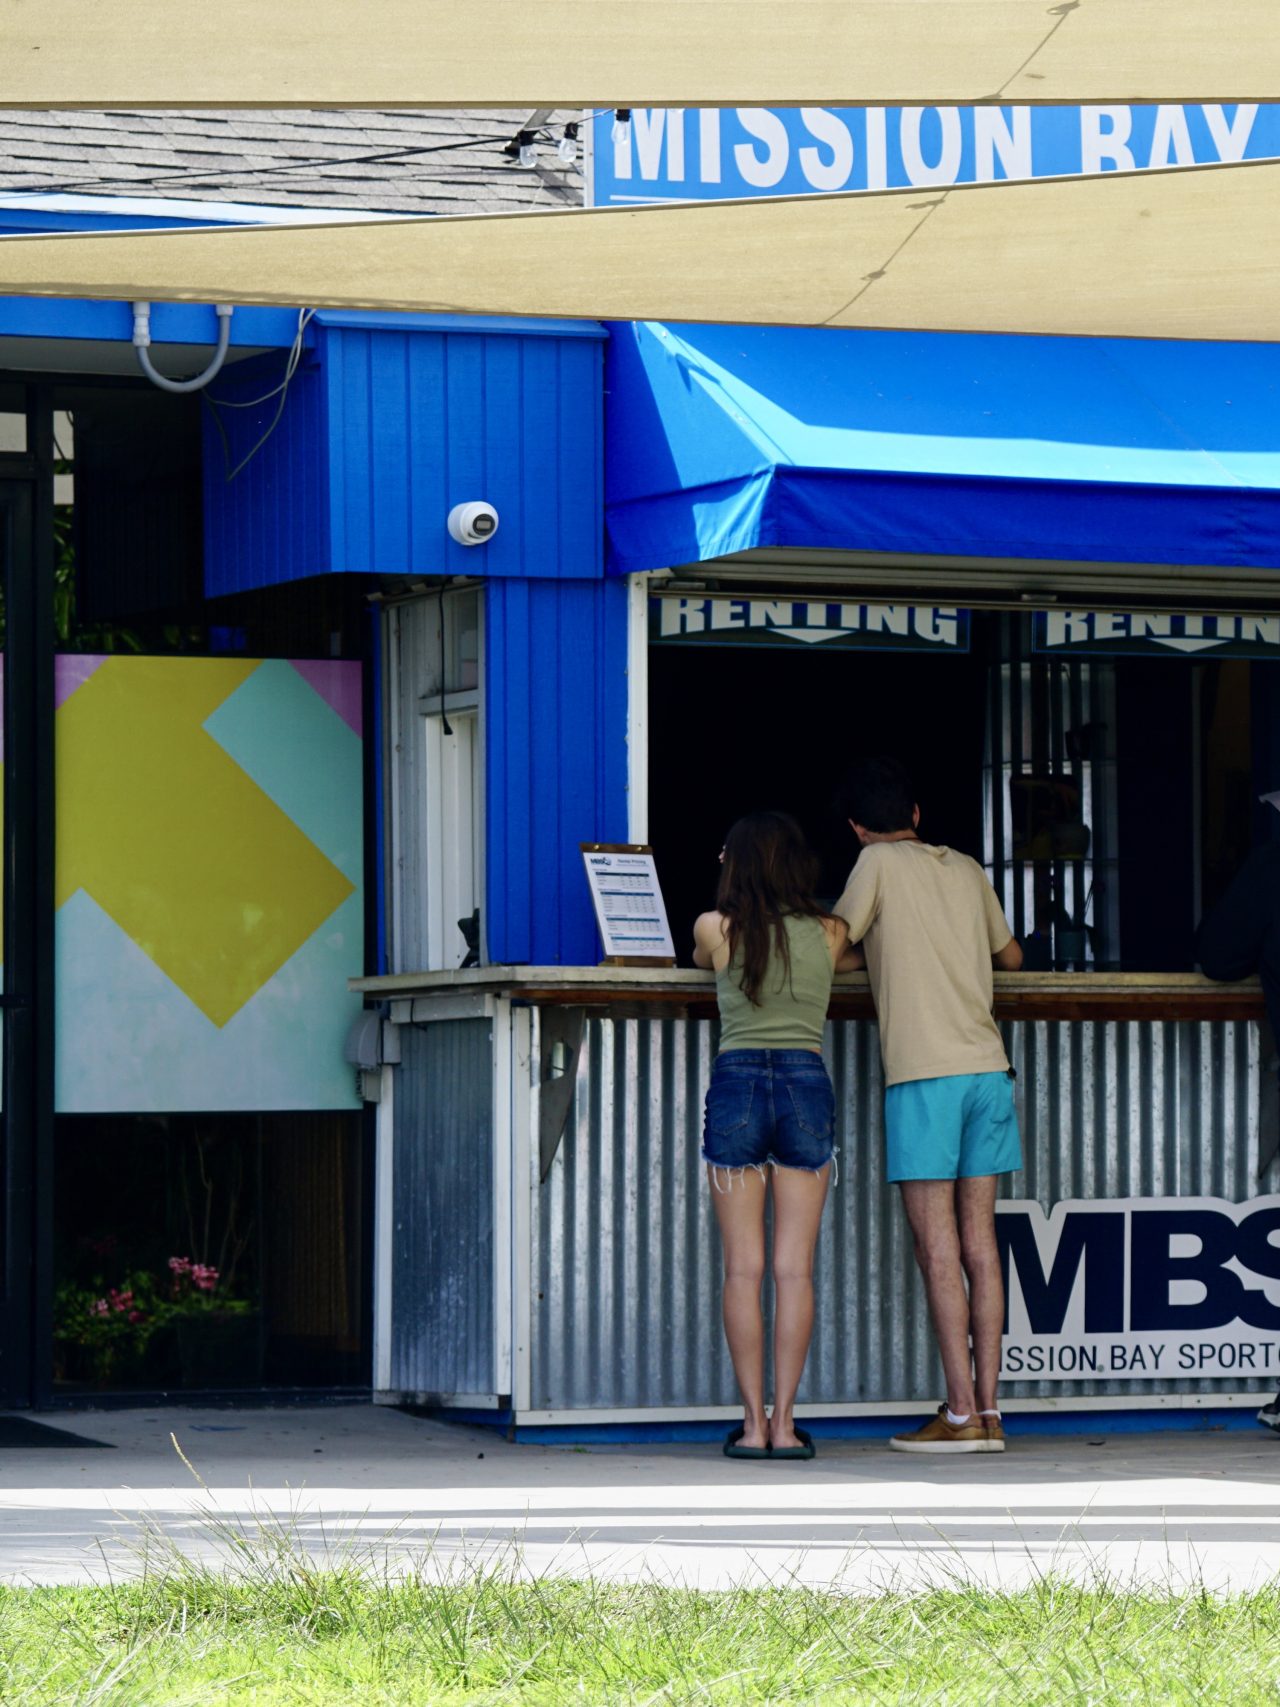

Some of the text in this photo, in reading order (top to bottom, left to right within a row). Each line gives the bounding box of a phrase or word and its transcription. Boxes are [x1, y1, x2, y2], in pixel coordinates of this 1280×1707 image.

[612, 106, 1033, 191] MISSION
[1080, 104, 1259, 174] BAY
[999, 1345, 1097, 1373] ISSION
[1111, 1344, 1166, 1371] BAY
